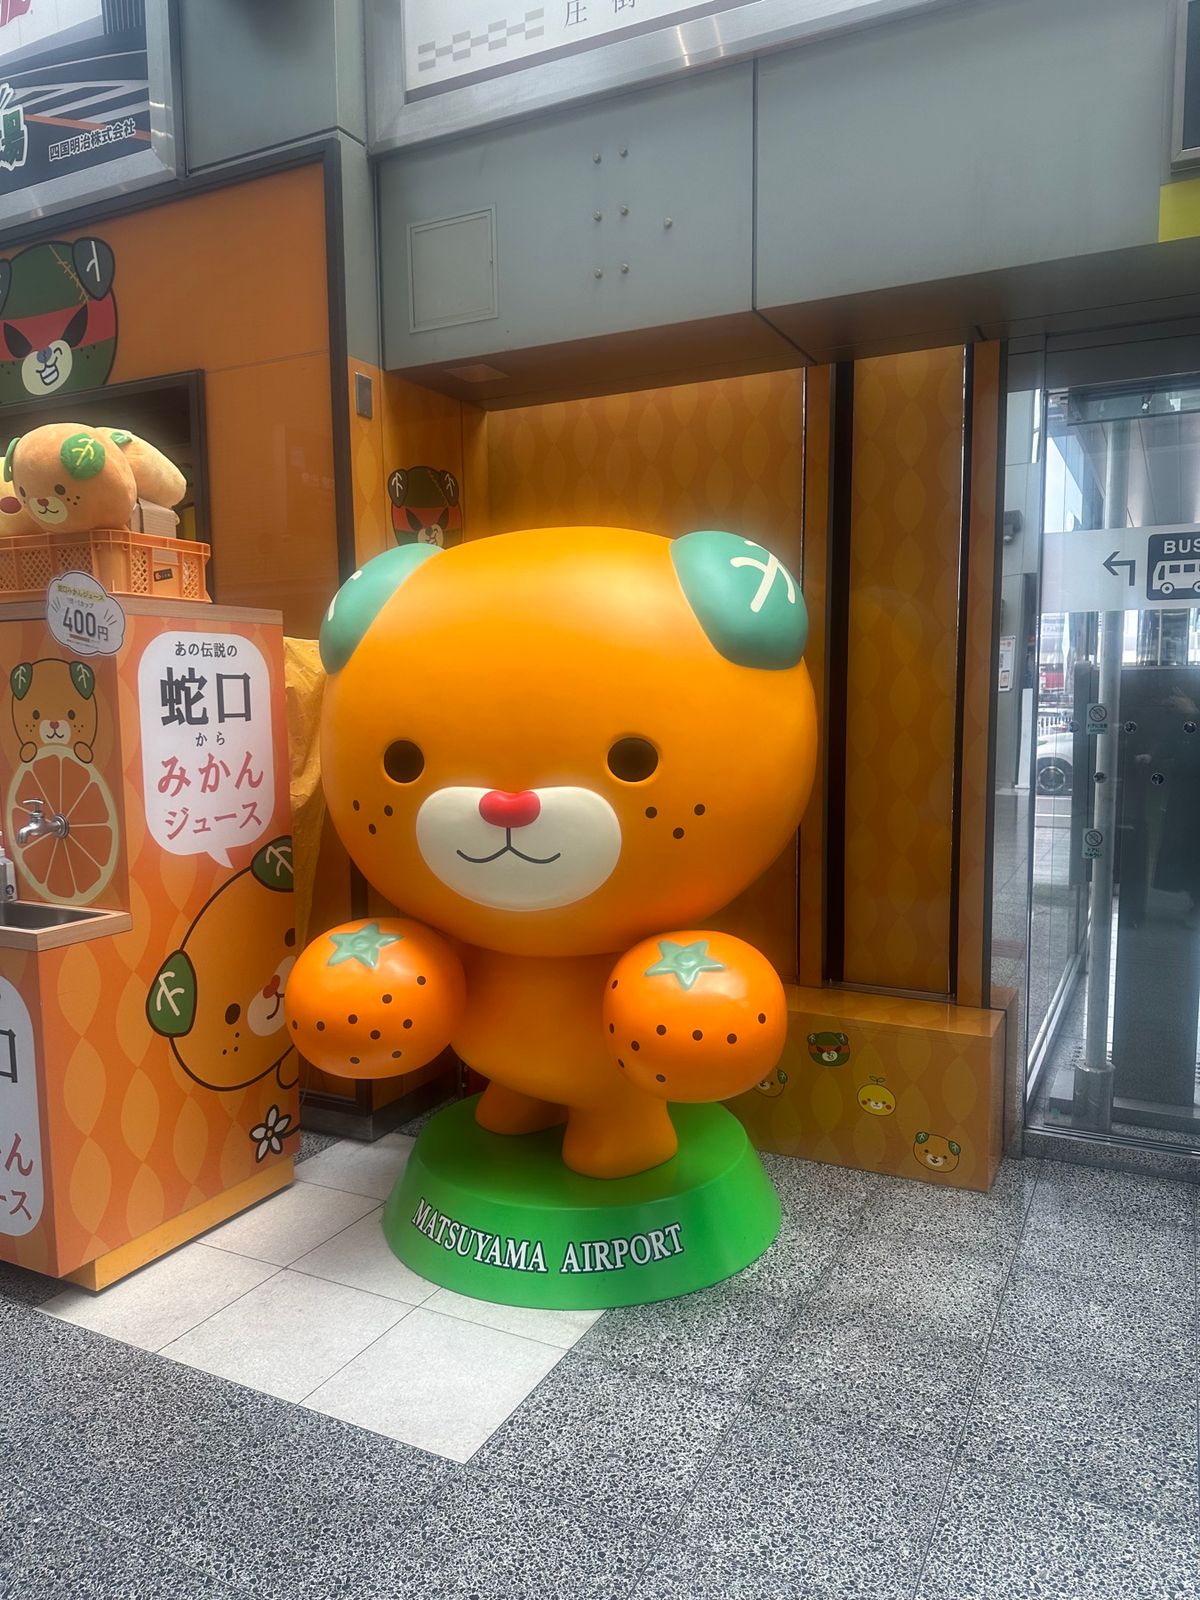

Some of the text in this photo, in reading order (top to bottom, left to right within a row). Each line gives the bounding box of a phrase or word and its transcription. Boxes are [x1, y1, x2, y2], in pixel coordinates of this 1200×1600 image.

[49, 118, 136, 161] 四国明治株式会社
[1164, 538, 1200, 554] BUS
[63, 607, 109, 641] 400円
[175, 641, 238, 658] あの伝説の
[160, 666, 252, 726] 蛇口
[196, 731, 226, 747] から
[158, 751, 264, 797] みかん
[165, 801, 263, 840] ジュース
[411, 1197, 684, 1274] MATSUYAMA AIRPORT
